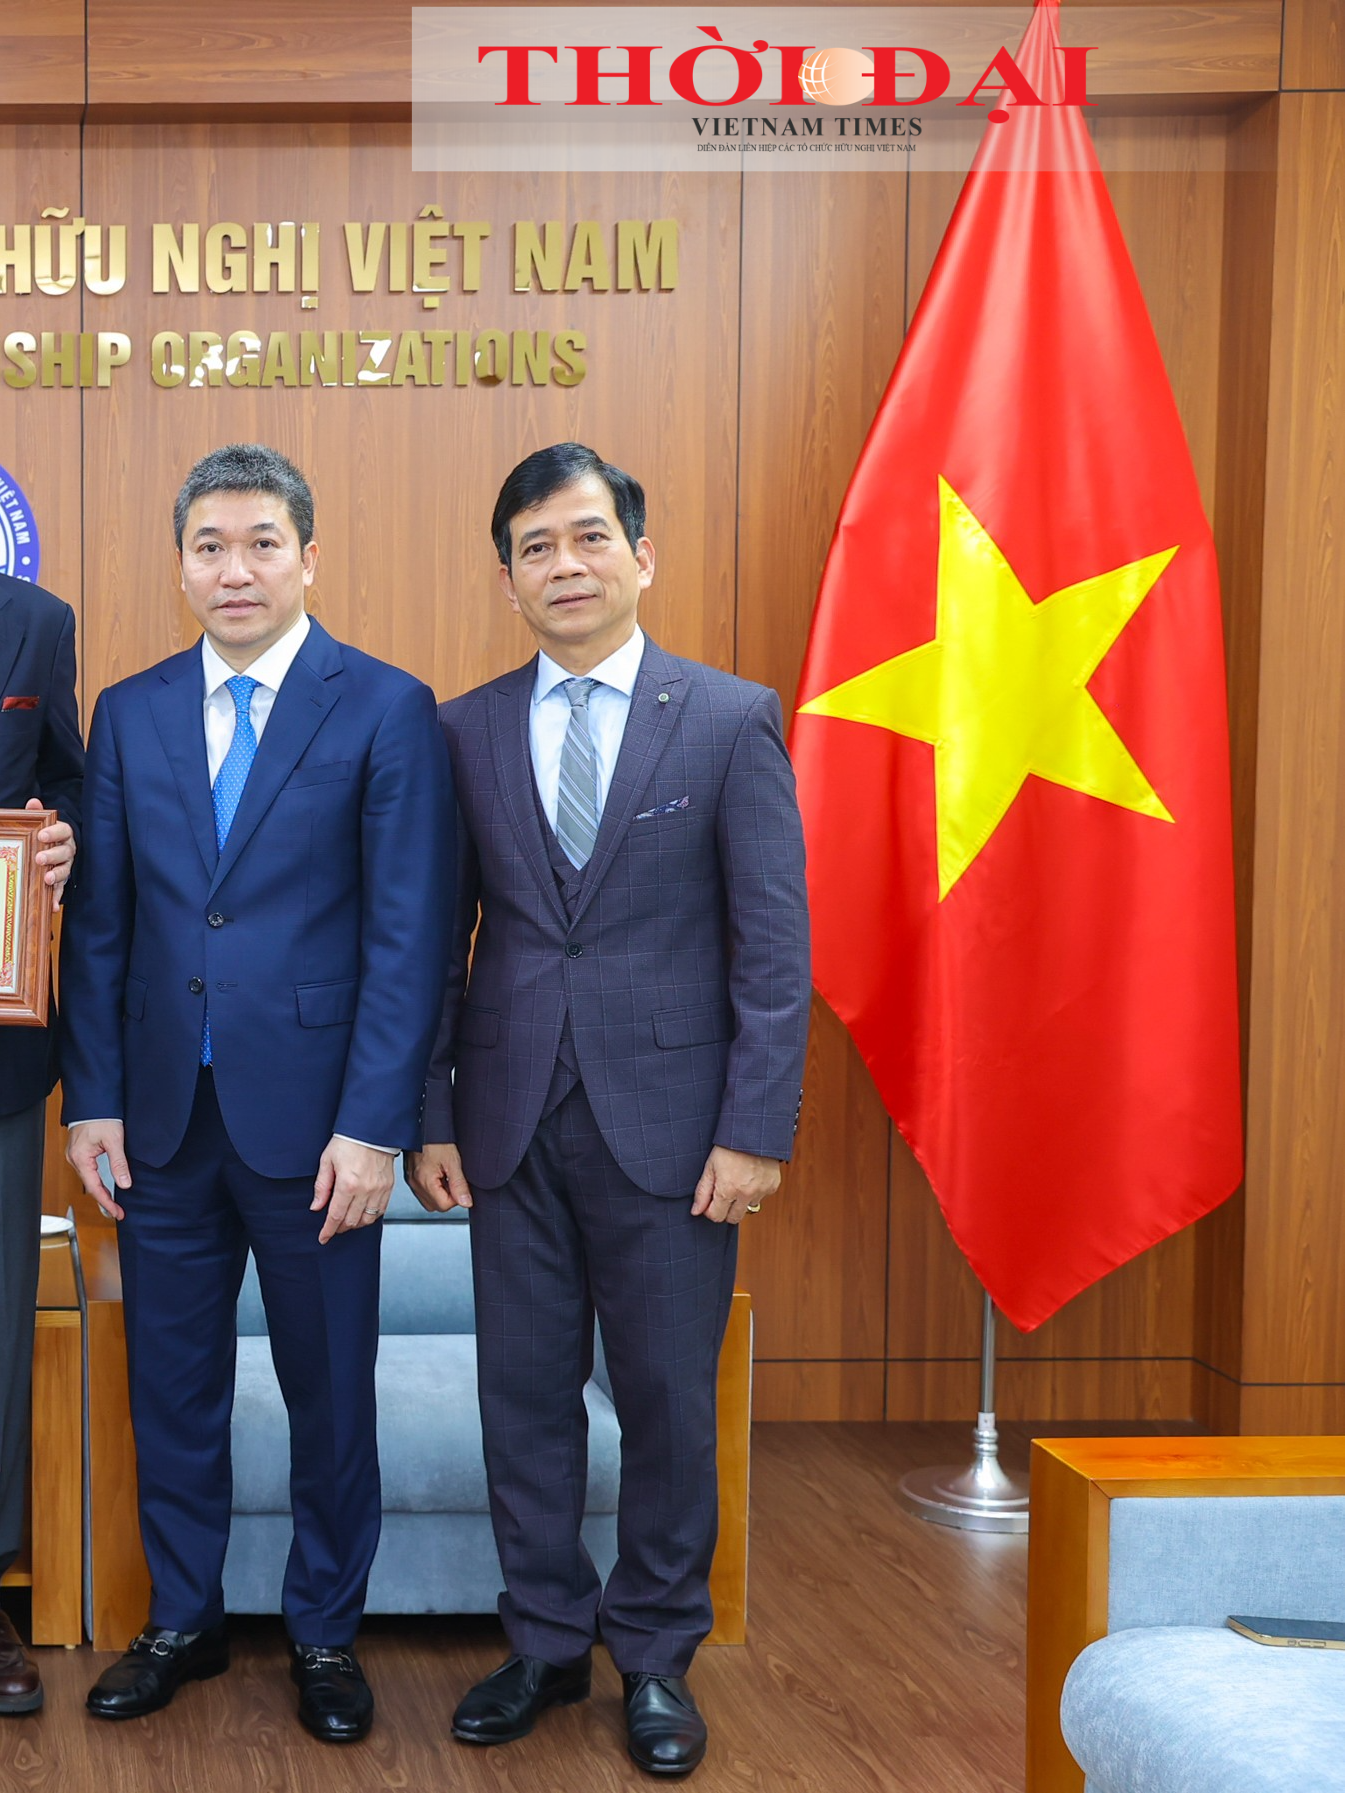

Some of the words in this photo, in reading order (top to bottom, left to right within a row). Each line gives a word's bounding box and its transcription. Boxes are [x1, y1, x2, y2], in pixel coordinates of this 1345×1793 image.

[152, 221, 319, 309] NGHỊ
[343, 204, 491, 309] VIỆT
[513, 218, 679, 292] NAM
[151, 330, 588, 389] ORGANIZATIONS
[9, 509, 31, 545] NAM
